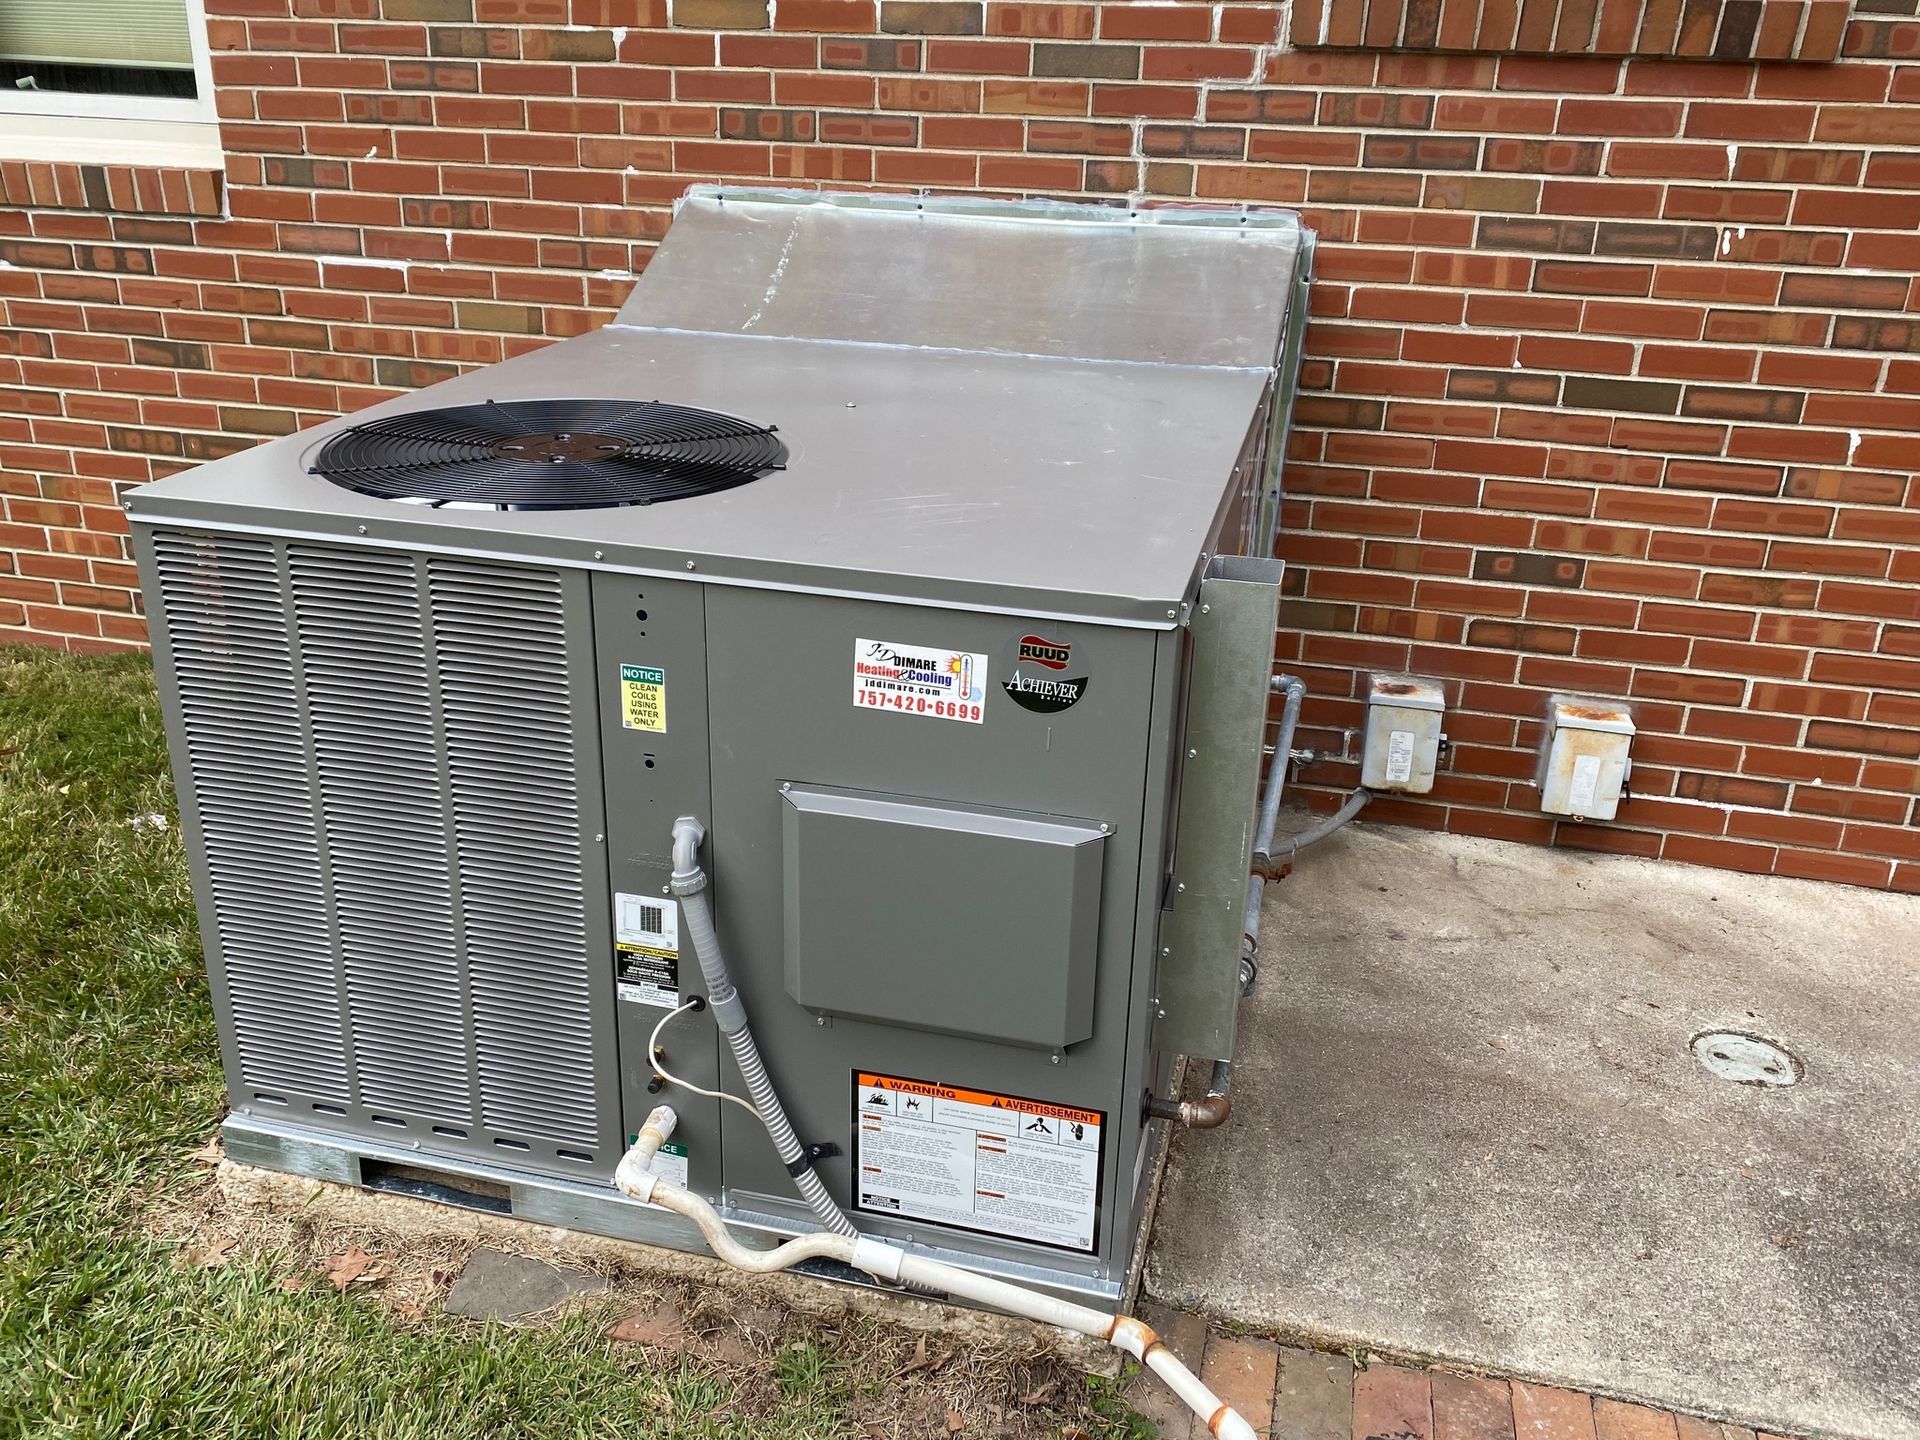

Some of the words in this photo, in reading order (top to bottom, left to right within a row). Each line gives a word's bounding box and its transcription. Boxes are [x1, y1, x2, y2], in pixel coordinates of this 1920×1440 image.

[1020, 644, 1069, 662] RUUD
[894, 656, 937, 671] DIMARE
[624, 668, 661, 681] NOTICE
[630, 682, 657, 692] CLEAN
[865, 679, 941, 696] jddimare.com
[1006, 669, 1078, 699] ACHIEVER
[631, 691, 656, 701] COILS
[631, 700, 657, 710] USING
[630, 708, 659, 719] WATER
[634, 717, 656, 726] ONLY
[889, 1080, 956, 1098] WARNING
[1005, 1099, 1095, 1123] AVERTISSEMENT
